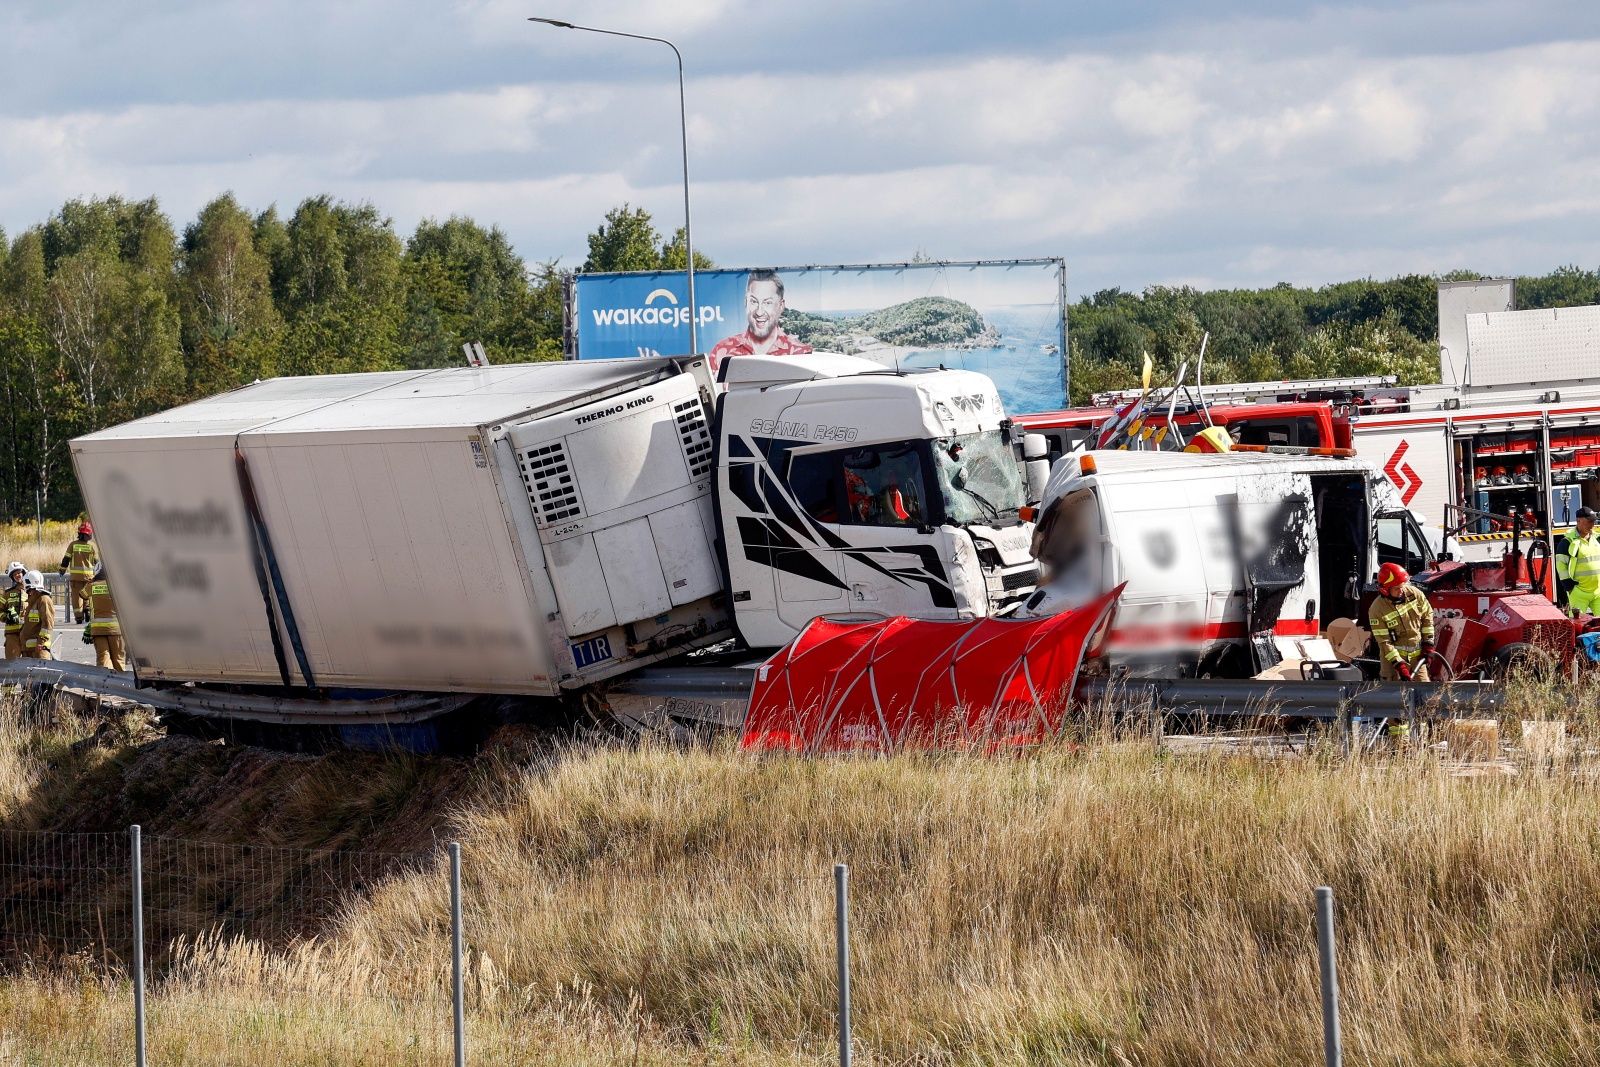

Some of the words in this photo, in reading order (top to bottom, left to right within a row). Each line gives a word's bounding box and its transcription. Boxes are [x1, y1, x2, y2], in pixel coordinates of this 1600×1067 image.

[593, 305, 724, 328] wakacje.pl
[575, 405, 624, 425] THERMO
[626, 395, 655, 410] KING
[750, 418, 808, 439] SCANIA
[814, 424, 859, 442] R450
[574, 638, 609, 665] TIR
